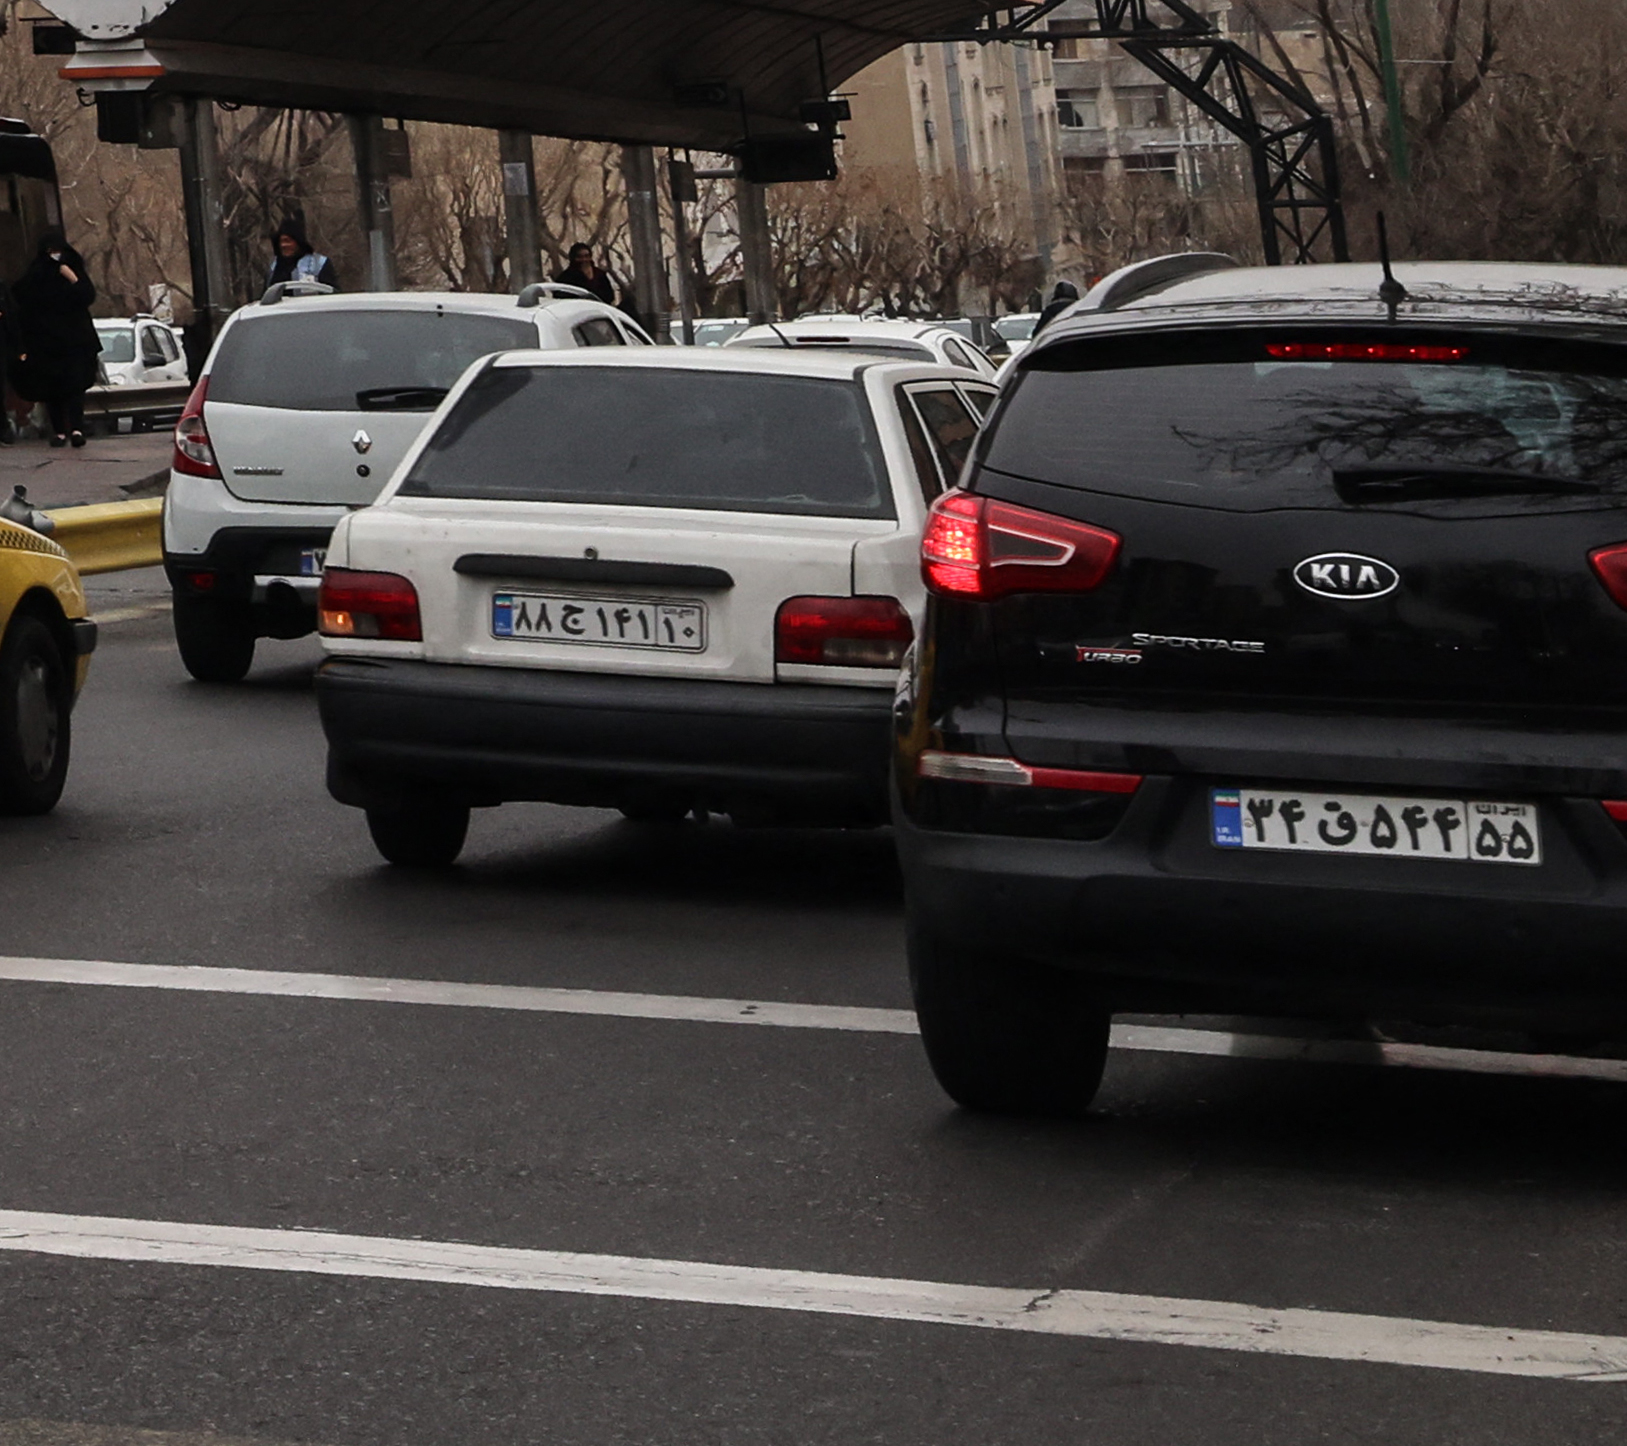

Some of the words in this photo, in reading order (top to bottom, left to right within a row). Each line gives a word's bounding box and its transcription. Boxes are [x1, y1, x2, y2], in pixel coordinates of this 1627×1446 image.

[1310, 563, 1382, 590] KIA
[1132, 633, 1265, 654] SPORTAGE
[1475, 818, 1534, 860] ۵۵
